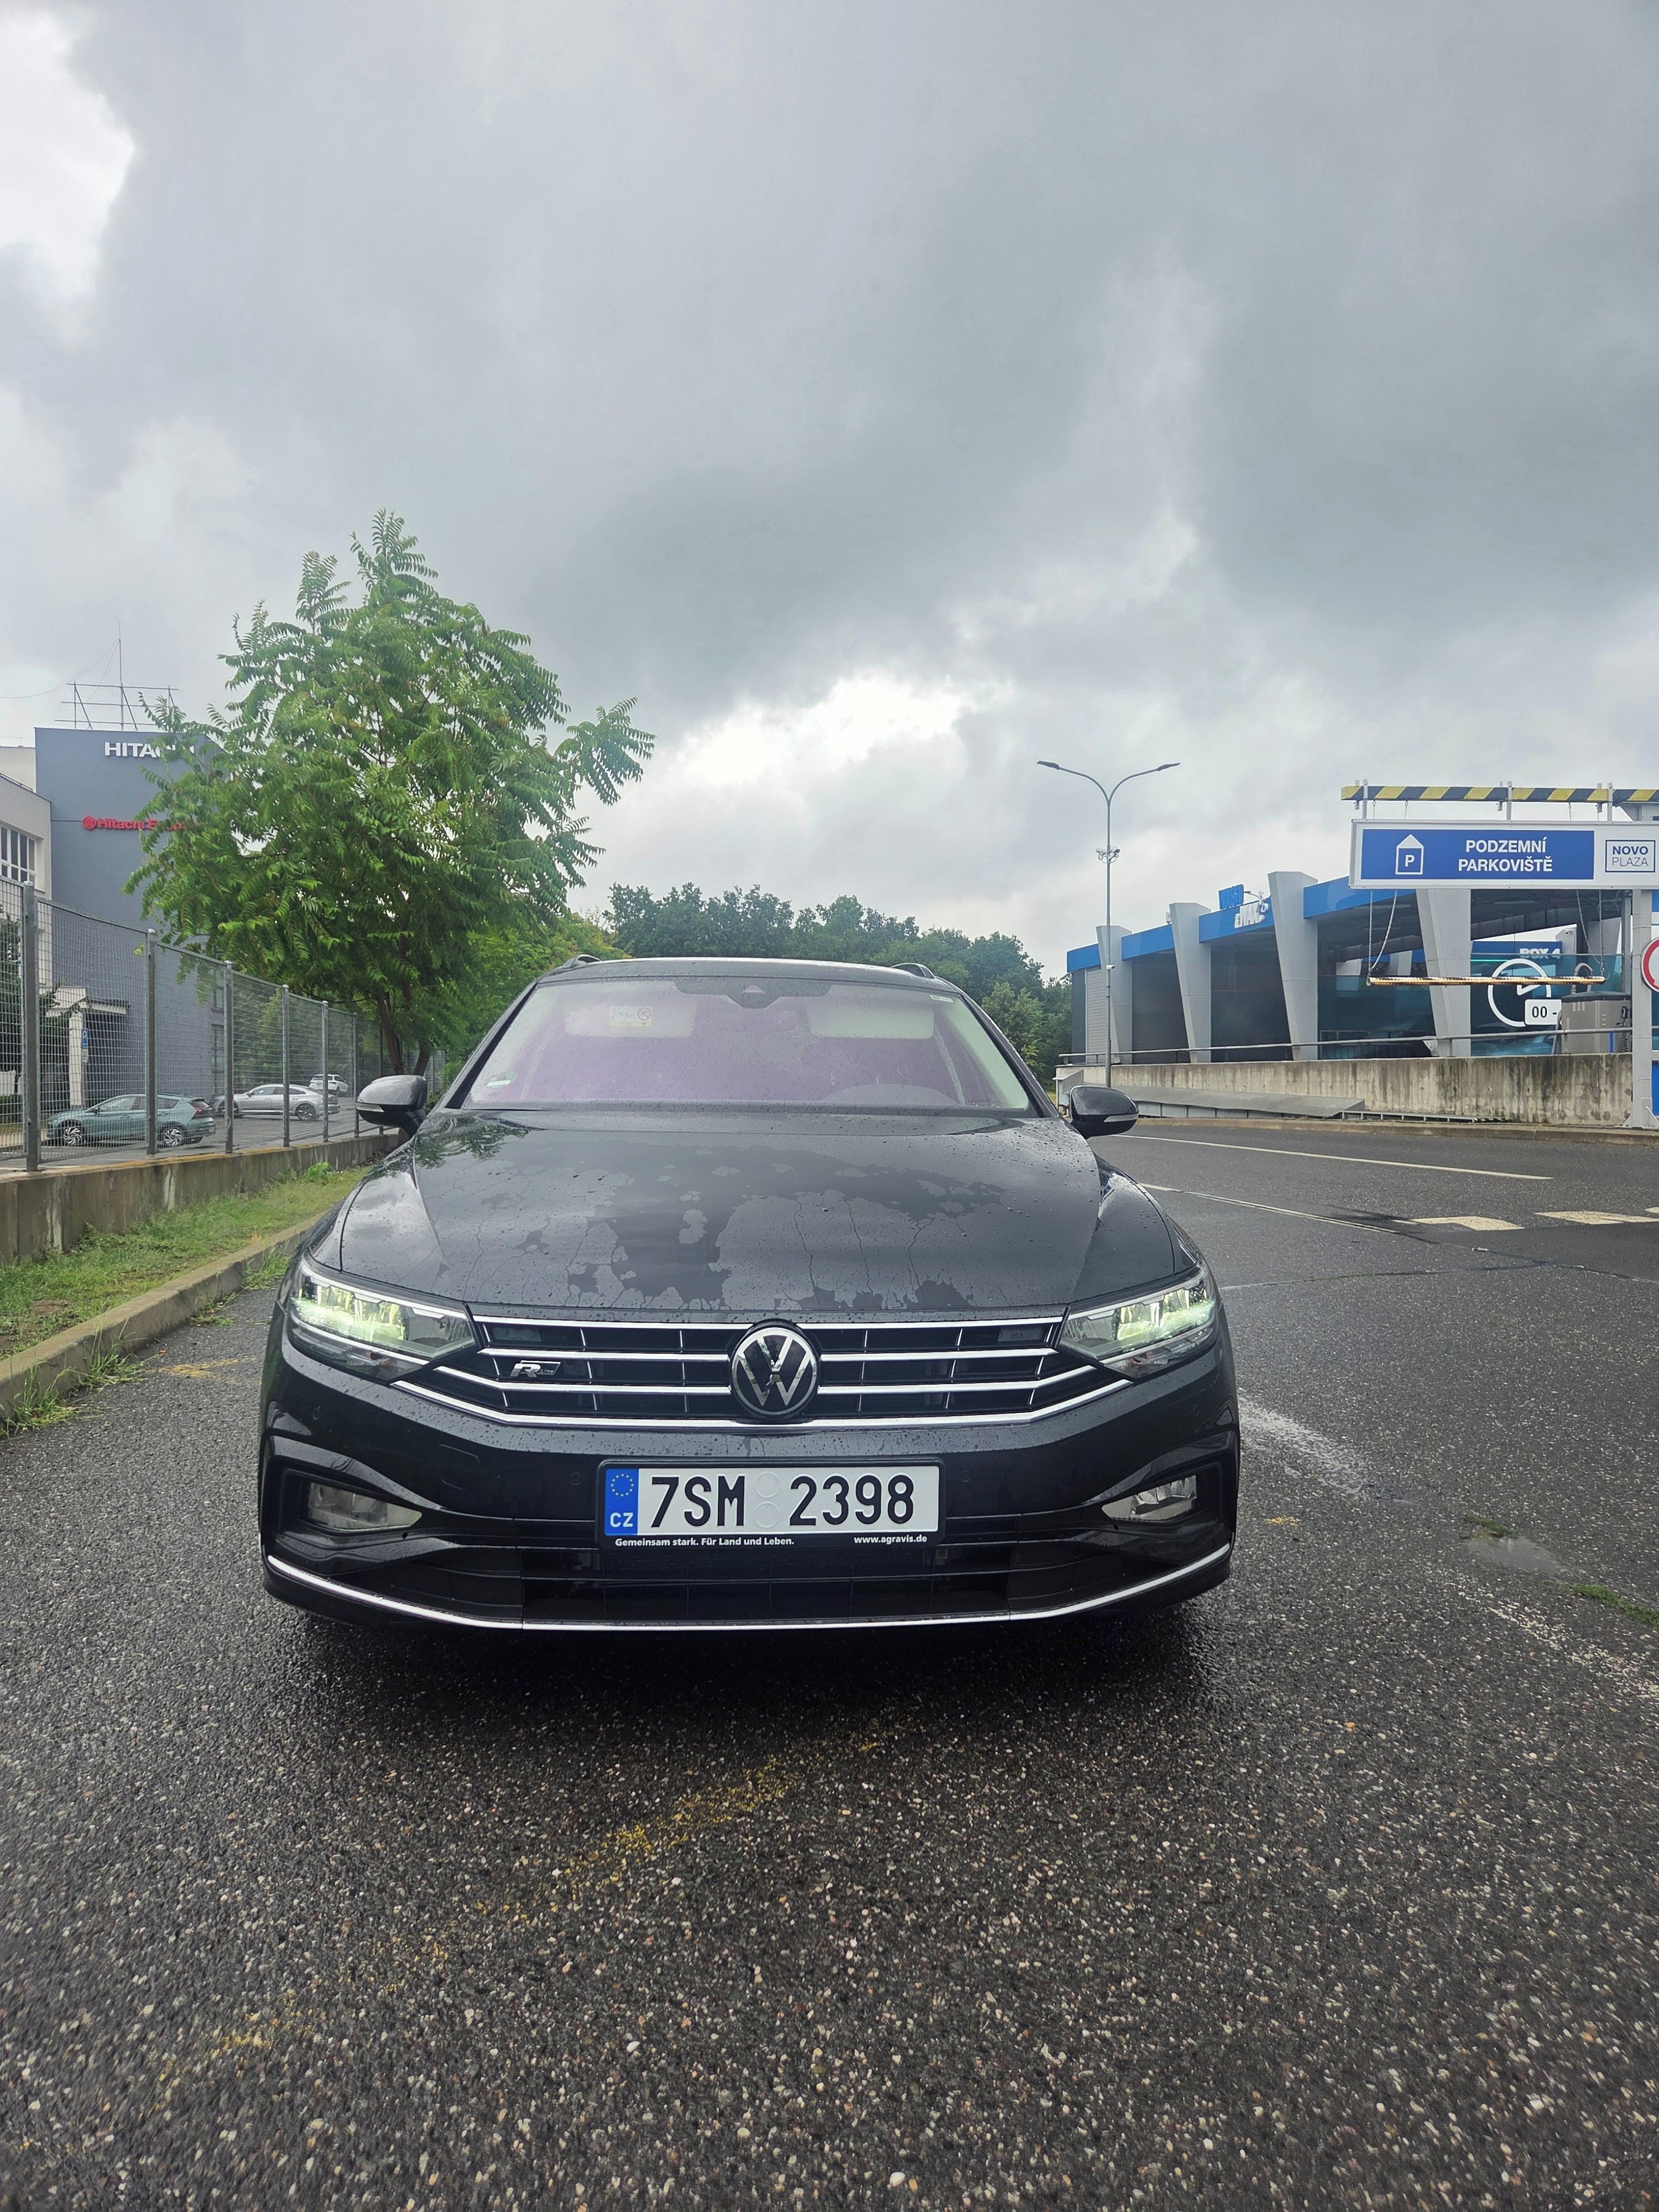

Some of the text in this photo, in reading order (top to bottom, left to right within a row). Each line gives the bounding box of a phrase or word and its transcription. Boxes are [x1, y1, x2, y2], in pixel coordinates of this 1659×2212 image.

[1466, 837, 1547, 853] PODZEMNÍ
[1612, 846, 1648, 855] NOVO
[1405, 855, 1415, 867] P
[1458, 855, 1552, 872] PARKOVIŠTĚ
[1612, 857, 1648, 867] PLAZA
[1519, 948, 1562, 959] BOX 4
[1531, 1006, 1548, 1018] 00
[651, 1474, 914, 1528] 7SM 2398
[609, 1512, 633, 1527] CZ
[615, 1538, 670, 1546] Gemeinsam
[701, 1537, 717, 1546] Für
[718, 1537, 741, 1546] Land
[764, 1537, 795, 1545] Leben.
[854, 1534, 927, 1545] www.agravis.de
